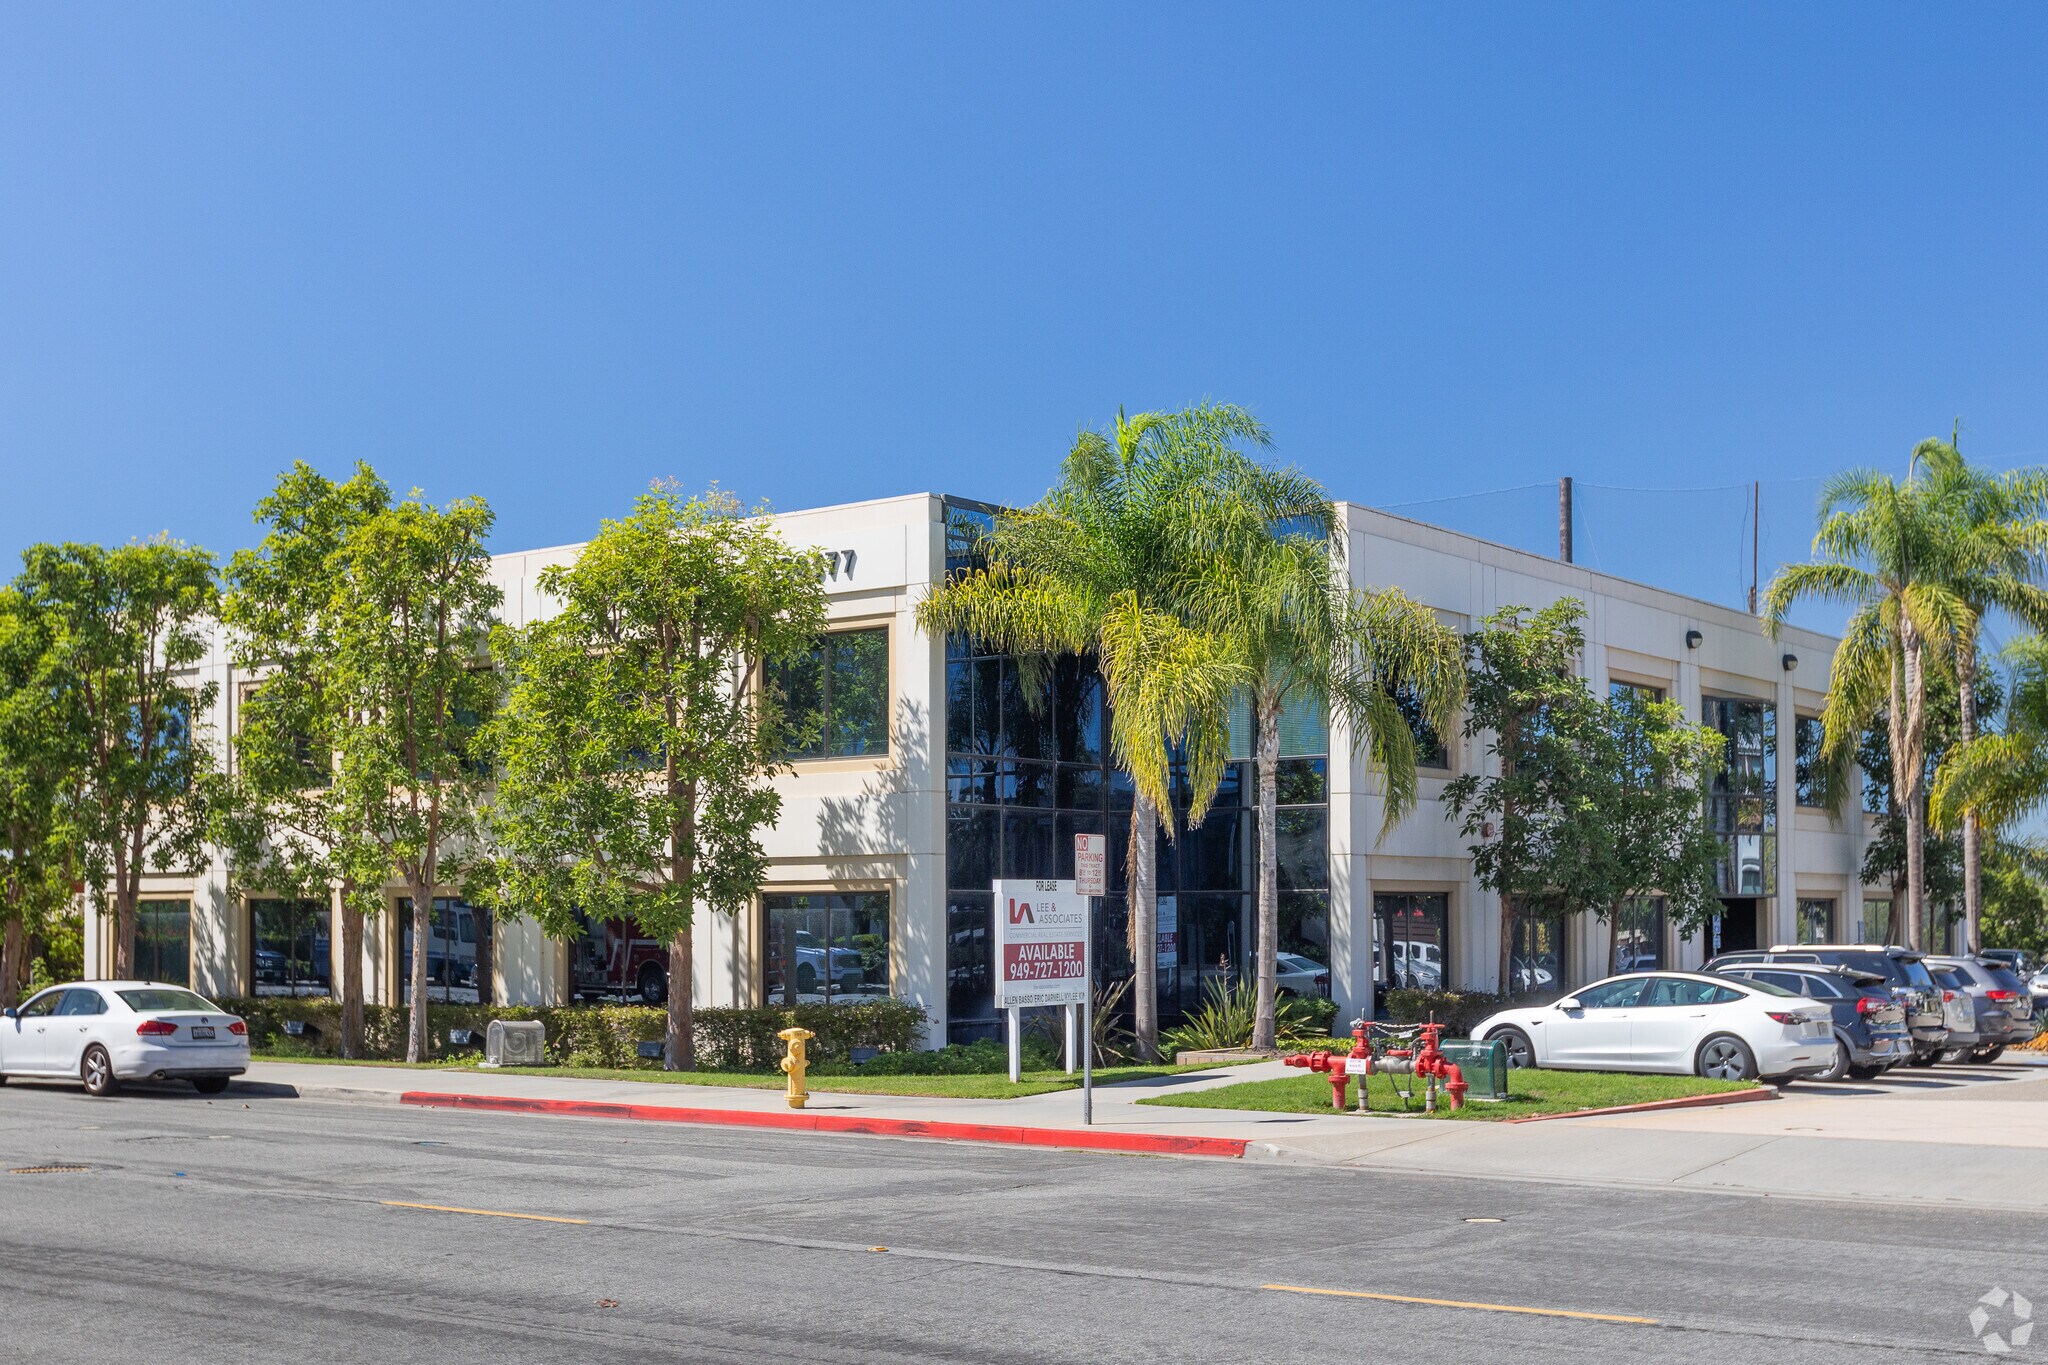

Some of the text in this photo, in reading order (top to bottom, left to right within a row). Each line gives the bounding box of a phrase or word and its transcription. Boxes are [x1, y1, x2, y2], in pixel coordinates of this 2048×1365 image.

[1077, 836, 1088, 850] NO
[1077, 853, 1103, 863] PARKING
[1036, 881, 1057, 892] FOR LEASE
[1036, 903, 1057, 912] LEE &
[1039, 913, 1083, 924] ASSOCIATES
[1009, 931, 1037, 939] COMMERCIAL
[1018, 944, 1074, 961] AVAILABLE
[1010, 960, 1083, 980] 949-727-1200
[1004, 996, 1018, 1005] ALLEN
[1019, 995, 1033, 1004] BASSO
[1034, 994, 1044, 1003] ERIC
[1045, 993, 1064, 1003] DARNELL
[1065, 992, 1078, 1002] KYLEE
